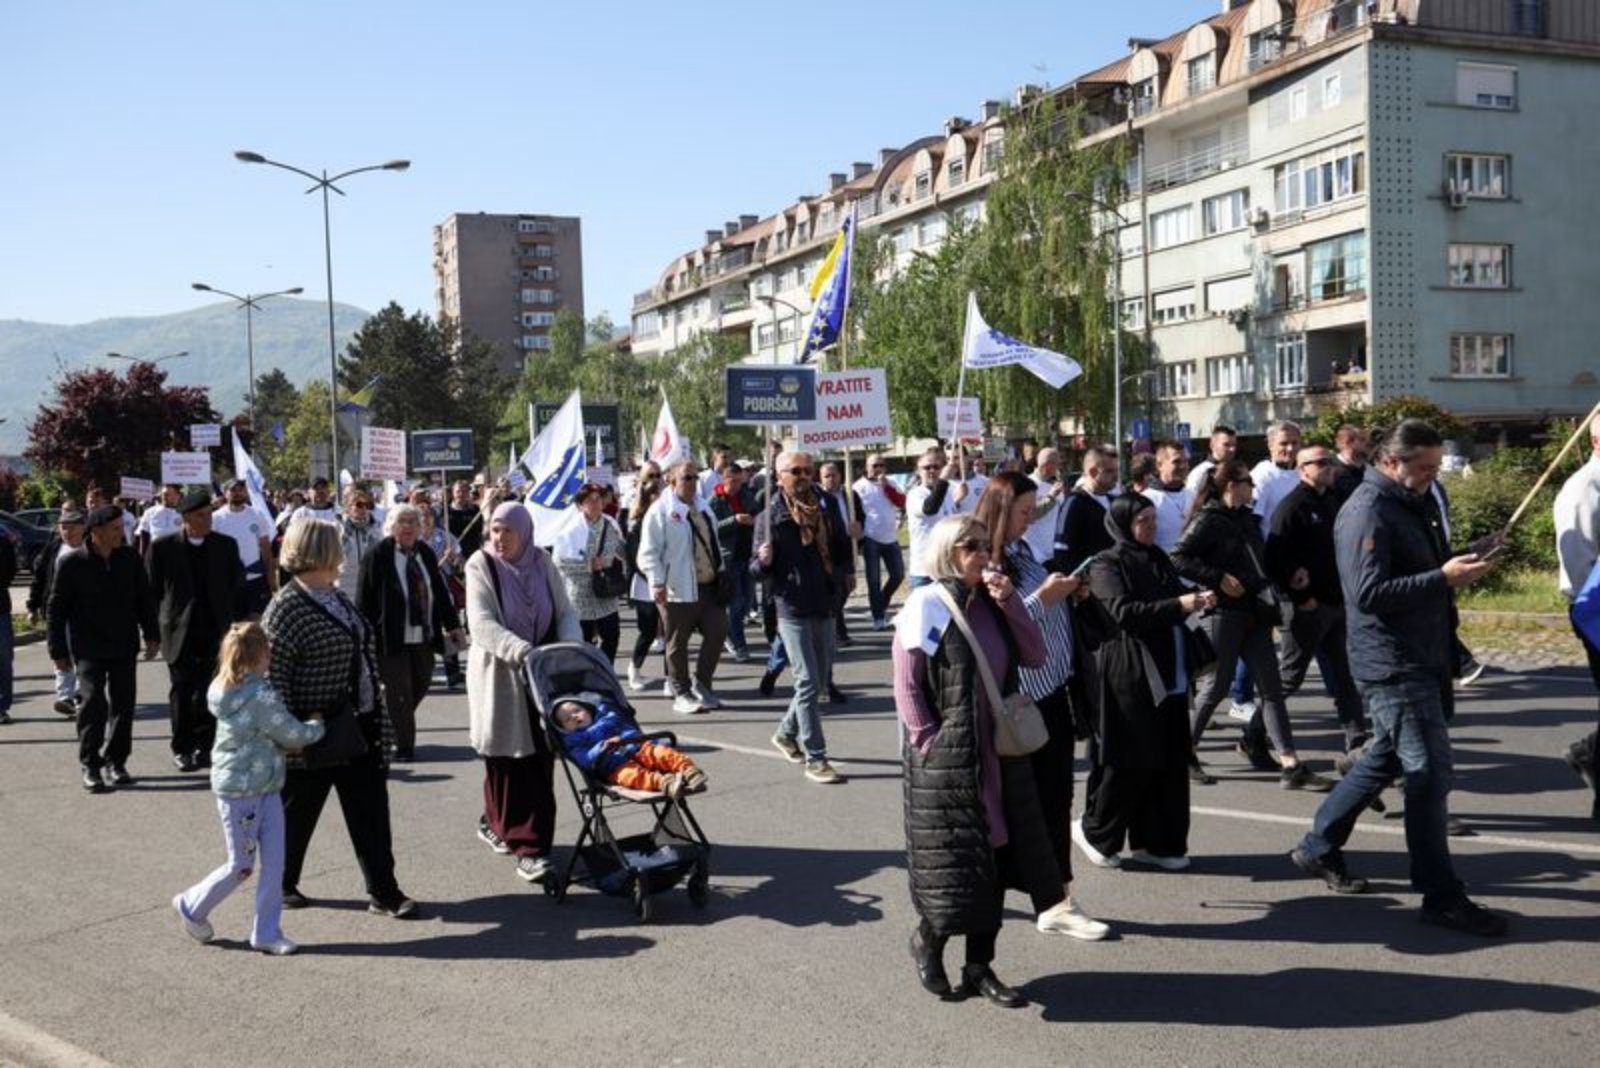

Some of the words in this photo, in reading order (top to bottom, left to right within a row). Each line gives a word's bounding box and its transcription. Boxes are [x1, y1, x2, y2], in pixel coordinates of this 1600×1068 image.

[815, 378, 873, 396] VRATITE
[743, 393, 799, 412] PODRŠKA
[826, 402, 863, 421] NAM
[803, 425, 887, 444] DOSTOJANSTVO!
